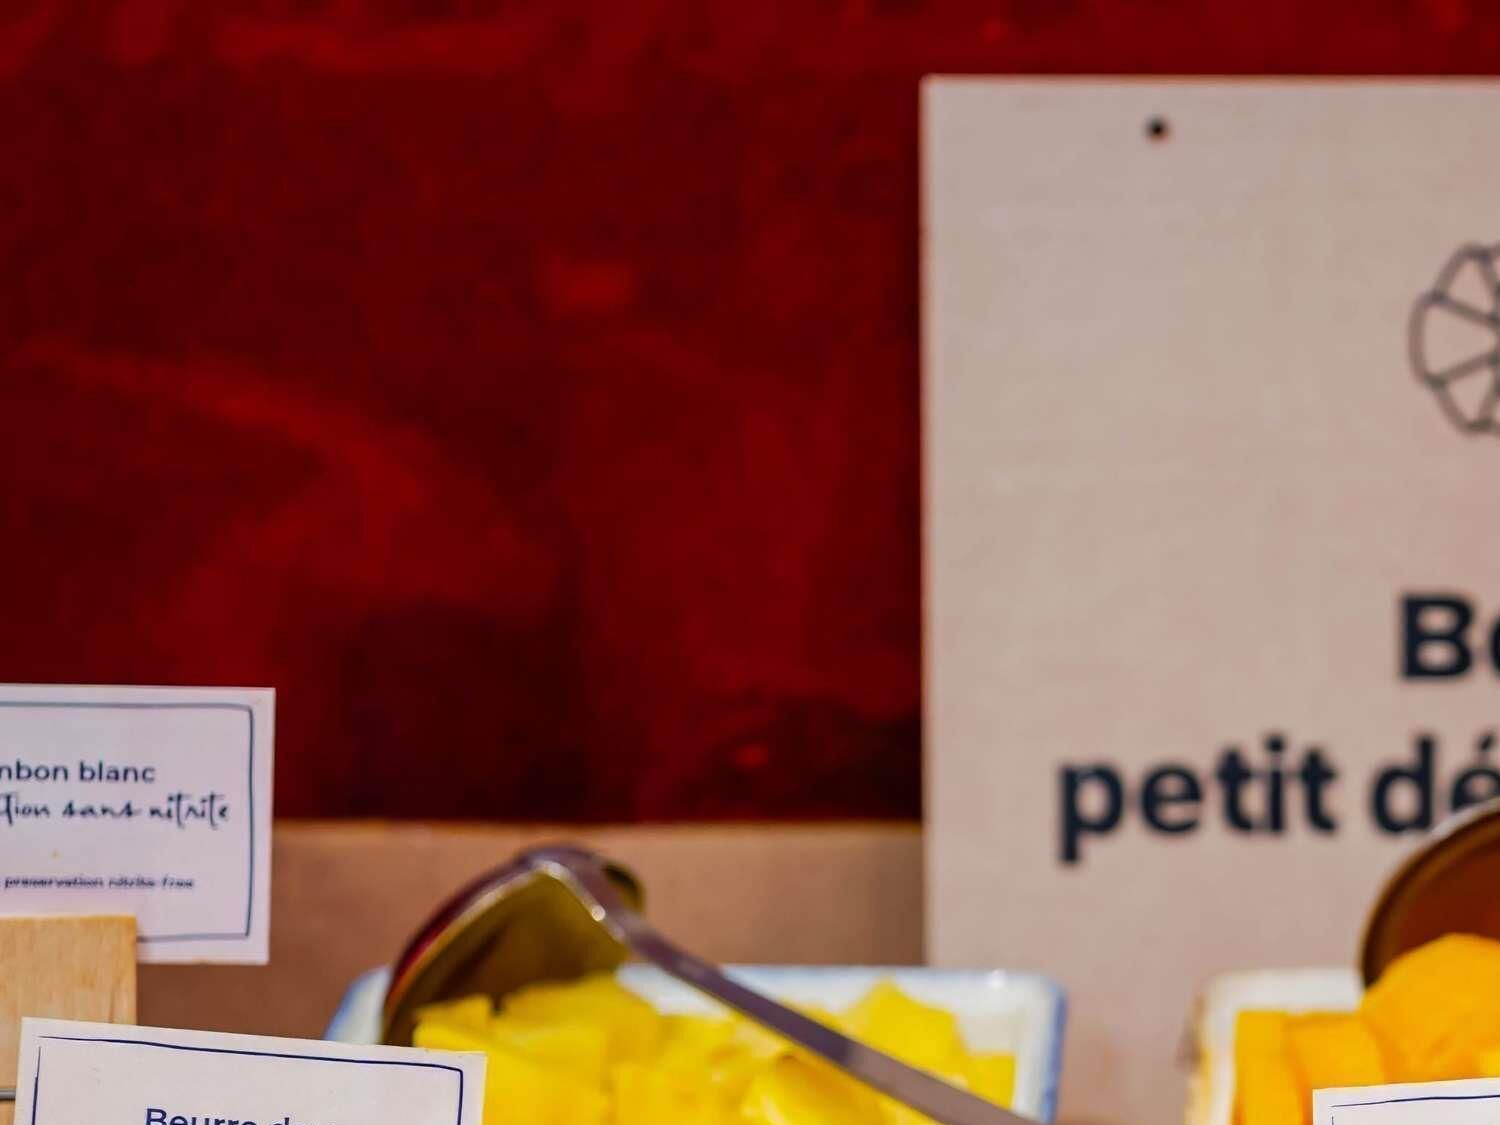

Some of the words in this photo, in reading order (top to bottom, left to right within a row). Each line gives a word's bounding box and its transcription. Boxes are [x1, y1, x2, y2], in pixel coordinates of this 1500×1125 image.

[79, 760, 155, 783] blanc
[62, 801, 140, 818] sans
[149, 791, 229, 828] nitrite
[1058, 734, 1339, 866] petit
